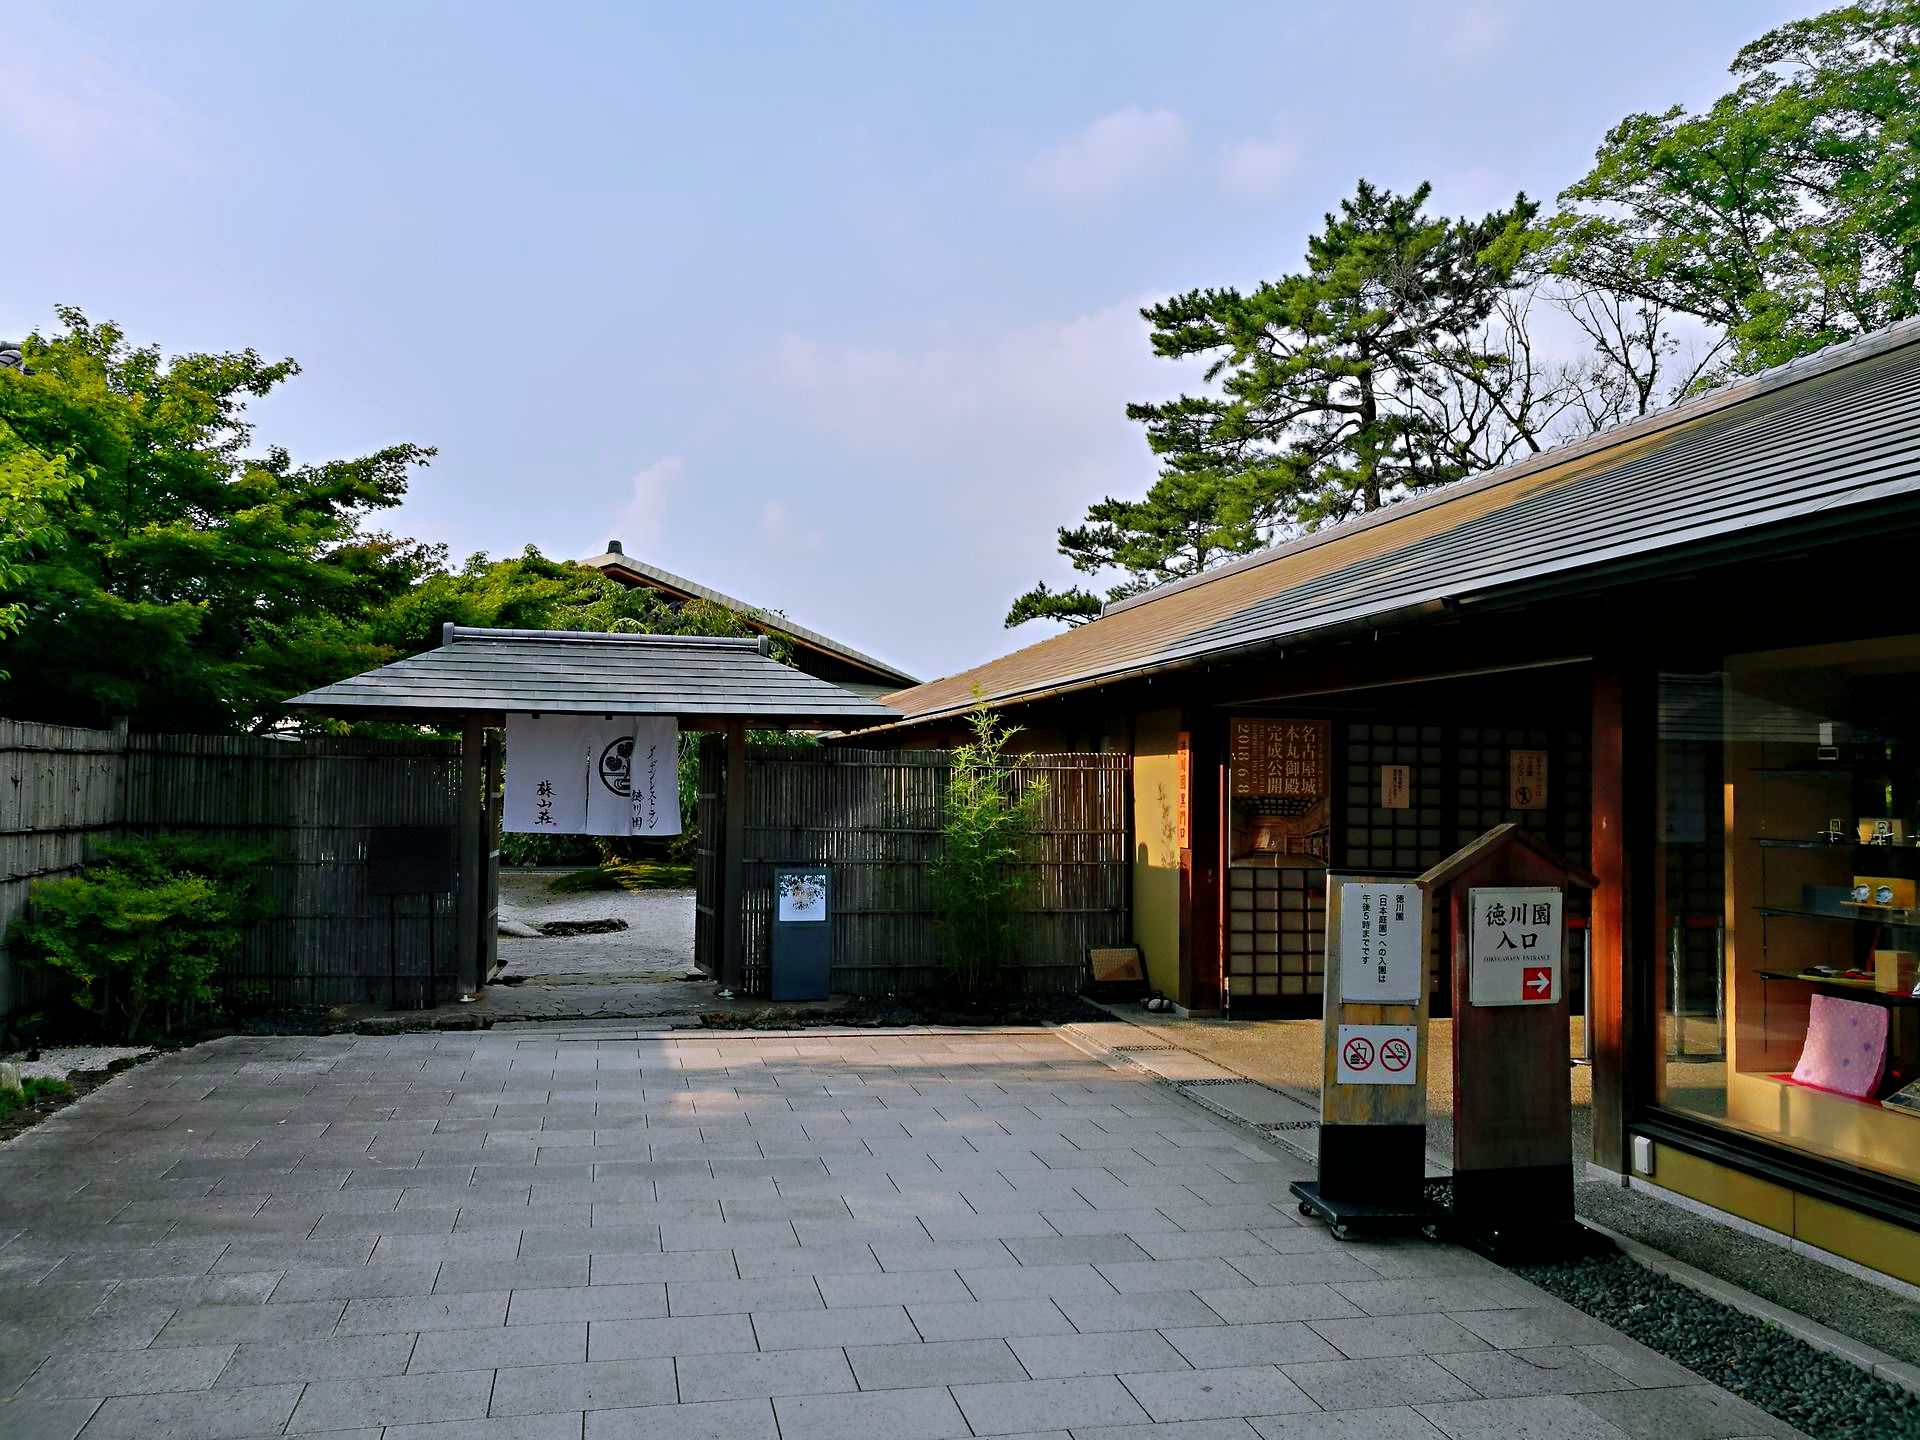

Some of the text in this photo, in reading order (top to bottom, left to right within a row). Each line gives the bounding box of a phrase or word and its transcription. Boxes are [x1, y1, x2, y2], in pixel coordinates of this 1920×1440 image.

[1267, 724, 1283, 794] 完成公開
[1285, 725, 1300, 794] 本丸御殿
[1301, 725, 1316, 794] 名古屋城
[535, 780, 557, 825] 蘇山荘
[1361, 893, 1371, 965] 午後5時までです
[1395, 894, 1405, 921] 徳川園
[1486, 902, 1552, 927] 徳川園
[1496, 931, 1538, 949] 入口
